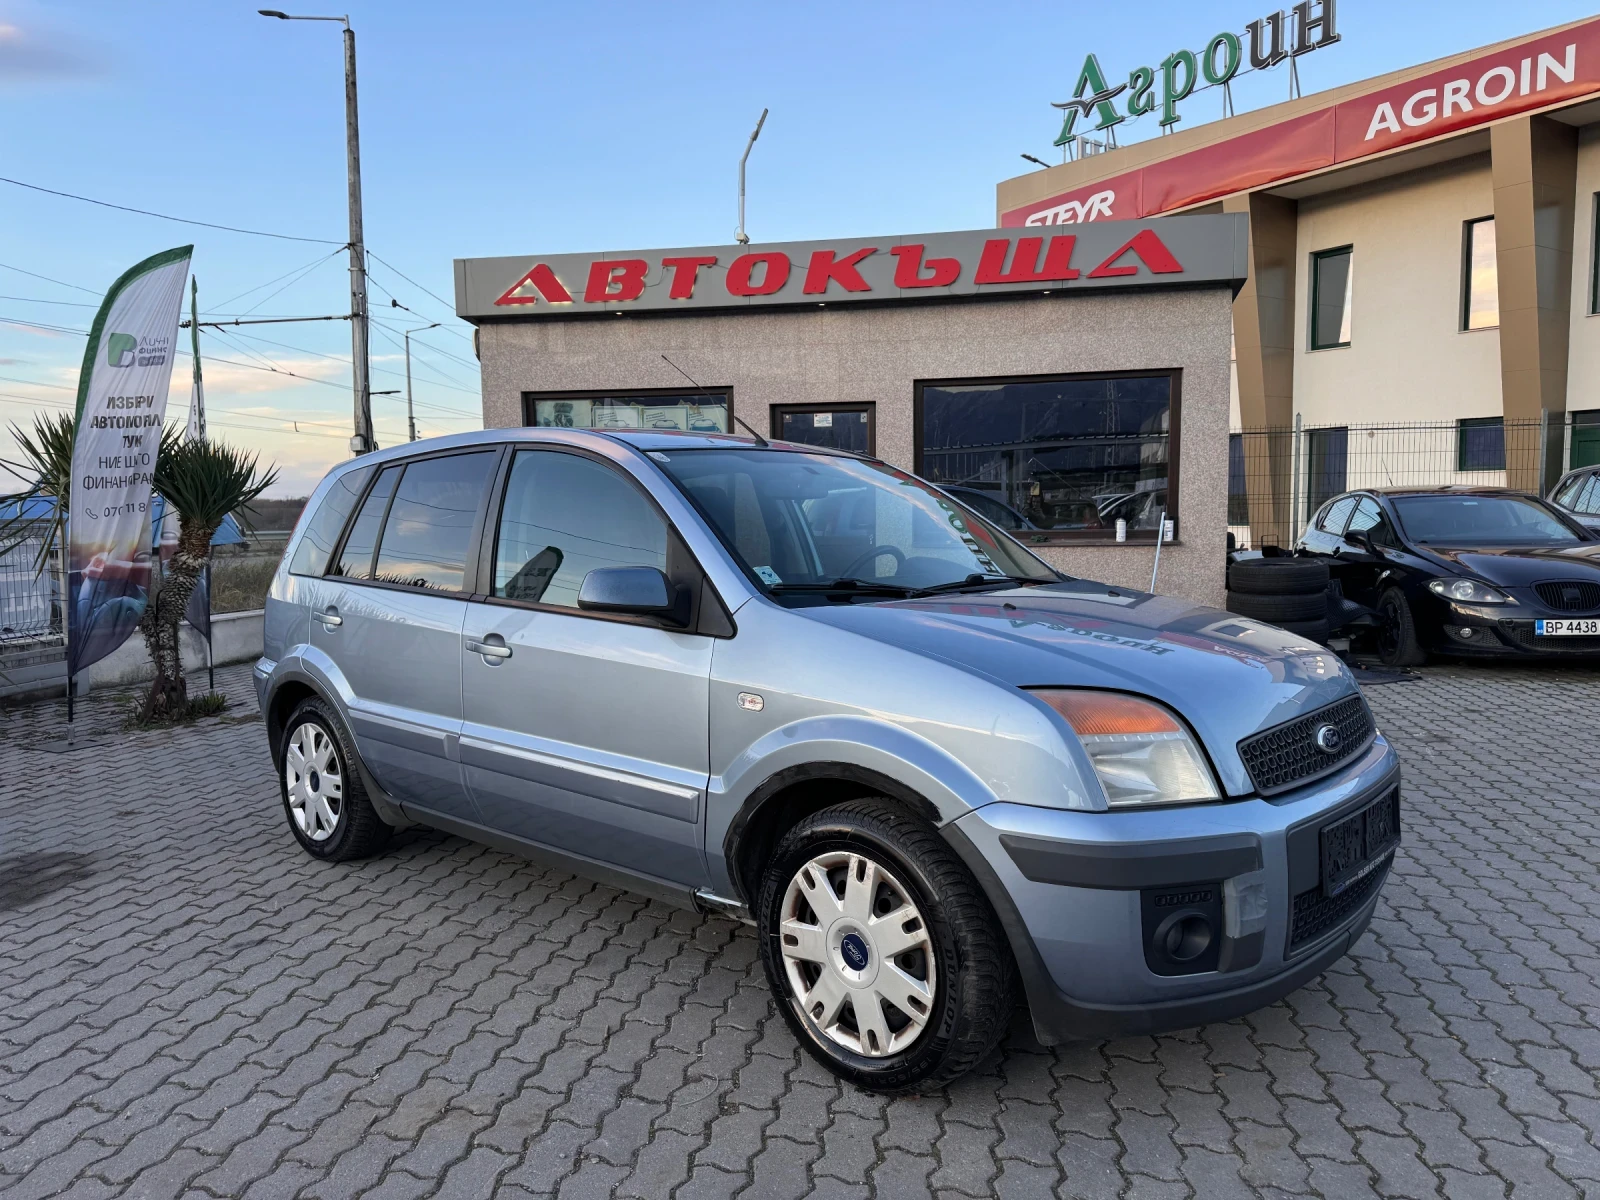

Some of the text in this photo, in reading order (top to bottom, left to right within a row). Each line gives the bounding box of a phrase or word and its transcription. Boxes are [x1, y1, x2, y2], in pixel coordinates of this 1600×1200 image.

[1364, 43, 1577, 141] AGROIN
[1025, 190, 1115, 227] STEYR
[1545, 621, 1598, 634] BP 4438
[944, 948, 958, 1035] DUNLOP
